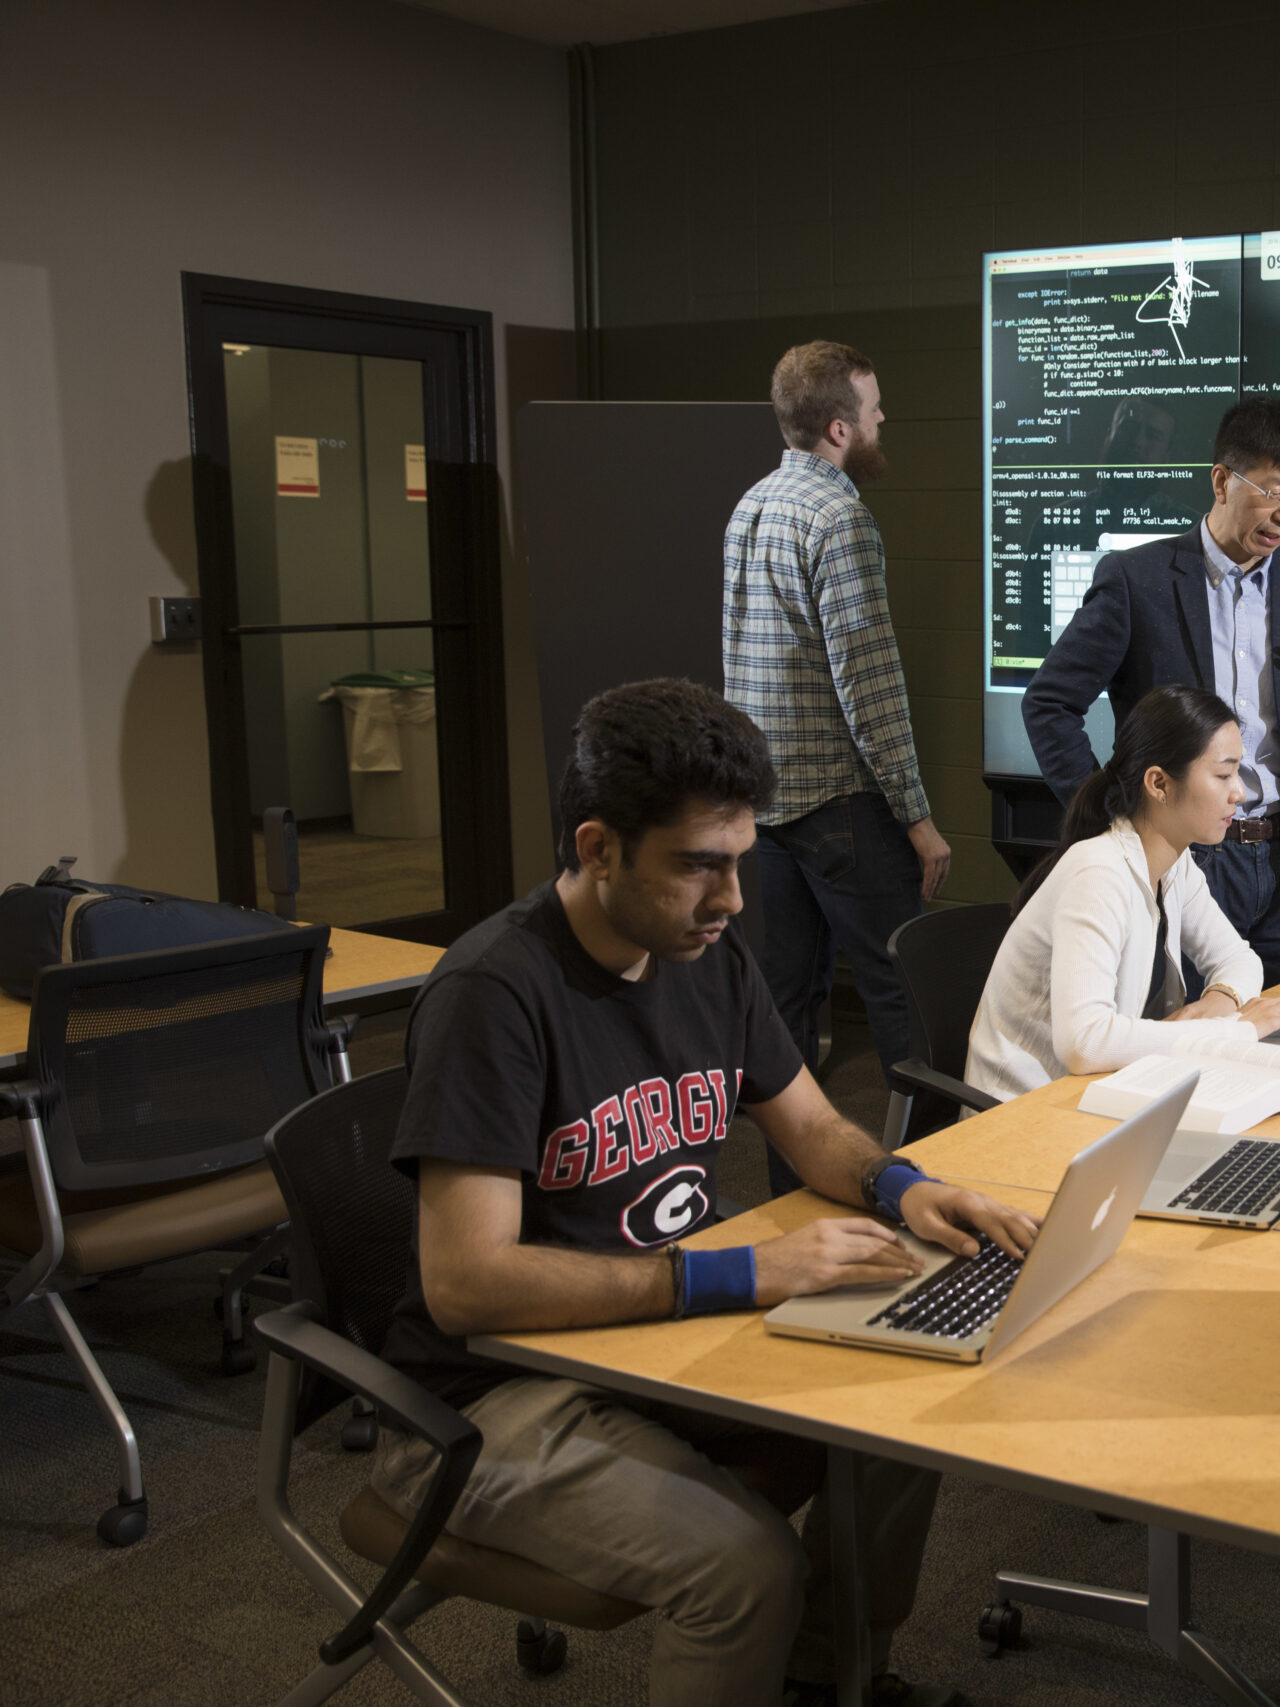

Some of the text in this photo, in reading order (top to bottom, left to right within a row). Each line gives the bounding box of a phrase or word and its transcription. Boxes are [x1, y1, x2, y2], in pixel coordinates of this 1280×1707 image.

[1017, 289, 1067, 299] except IOError:
[992, 315, 1090, 328] def get_info(data, func_dict):
[1017, 326, 1051, 335] binaryname
[1061, 324, 1114, 333] data.binary_name
[1018, 334, 1062, 343] function_list
[1071, 331, 1135, 342] data.raw_graph_list
[1018, 344, 1042, 353] func_id
[1051, 342, 1098, 352] len(func_dict)
[1018, 354, 1029, 362] for
[1048, 353, 1055, 361] in
[1058, 349, 1168, 361] random.sample(function_list,200):
[1043, 362, 1061, 371] #Only
[1064, 361, 1091, 369] Consider
[1094, 360, 1122, 368] function
[1125, 359, 1139, 367] with
[1148, 358, 1155, 366] of
[1158, 358, 1177, 366] basic
[1180, 357, 1198, 365] block
[1201, 356, 1223, 365] larger
[1226, 355, 1240, 363] than
[1070, 379, 1098, 387] continue
[1017, 416, 1061, 426] print func_id
[1005, 435, 1056, 445] parse_command():
[1137, 470, 1193, 478] ELF32-arm-little
[992, 490, 1029, 499] Disassembly
[1041, 489, 1064, 497] section
[1068, 489, 1086, 497] .init:
[1096, 508, 1110, 517] push
[992, 552, 1028, 561] Disassembly
[537, 1069, 743, 1191] GEORGI
